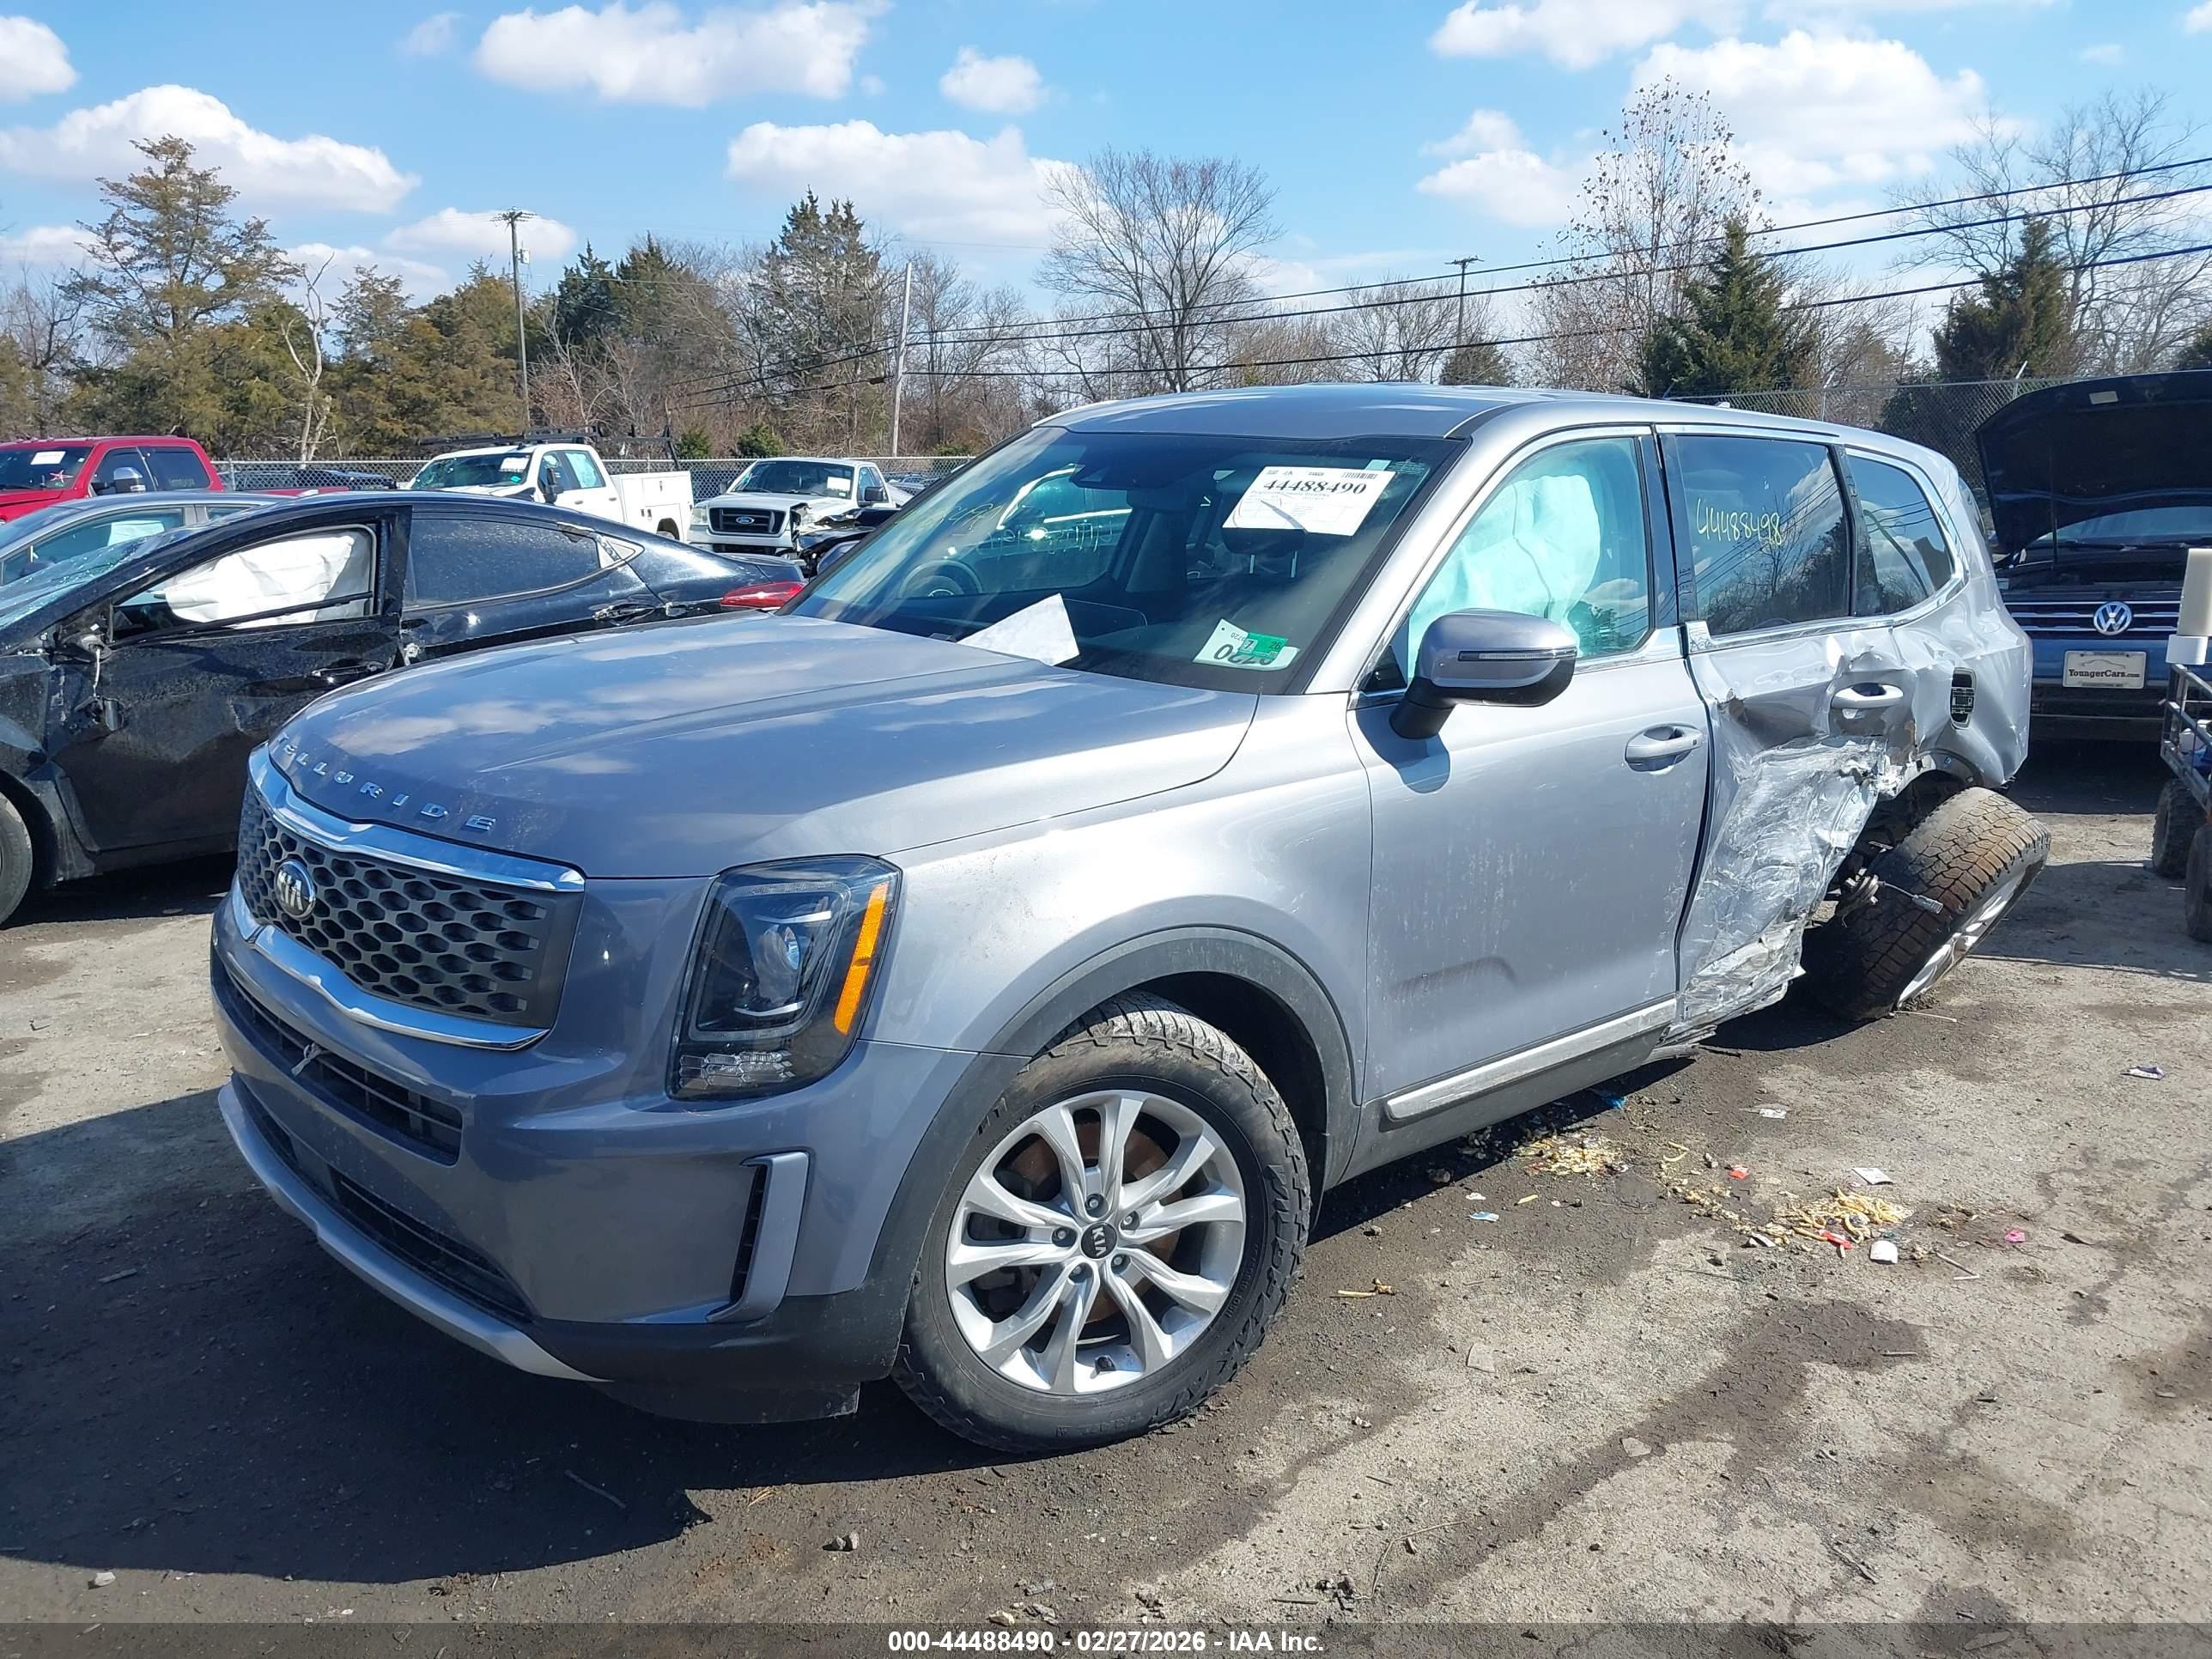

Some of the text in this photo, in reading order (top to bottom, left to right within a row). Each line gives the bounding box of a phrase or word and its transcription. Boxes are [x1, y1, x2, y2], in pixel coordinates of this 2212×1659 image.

[1263, 479, 1368, 495] 44488490
[2069, 669, 2140, 678] YoungerCars.com
[276, 732, 496, 832] TELLURIDE
[1091, 1226, 1107, 1257] KIA
